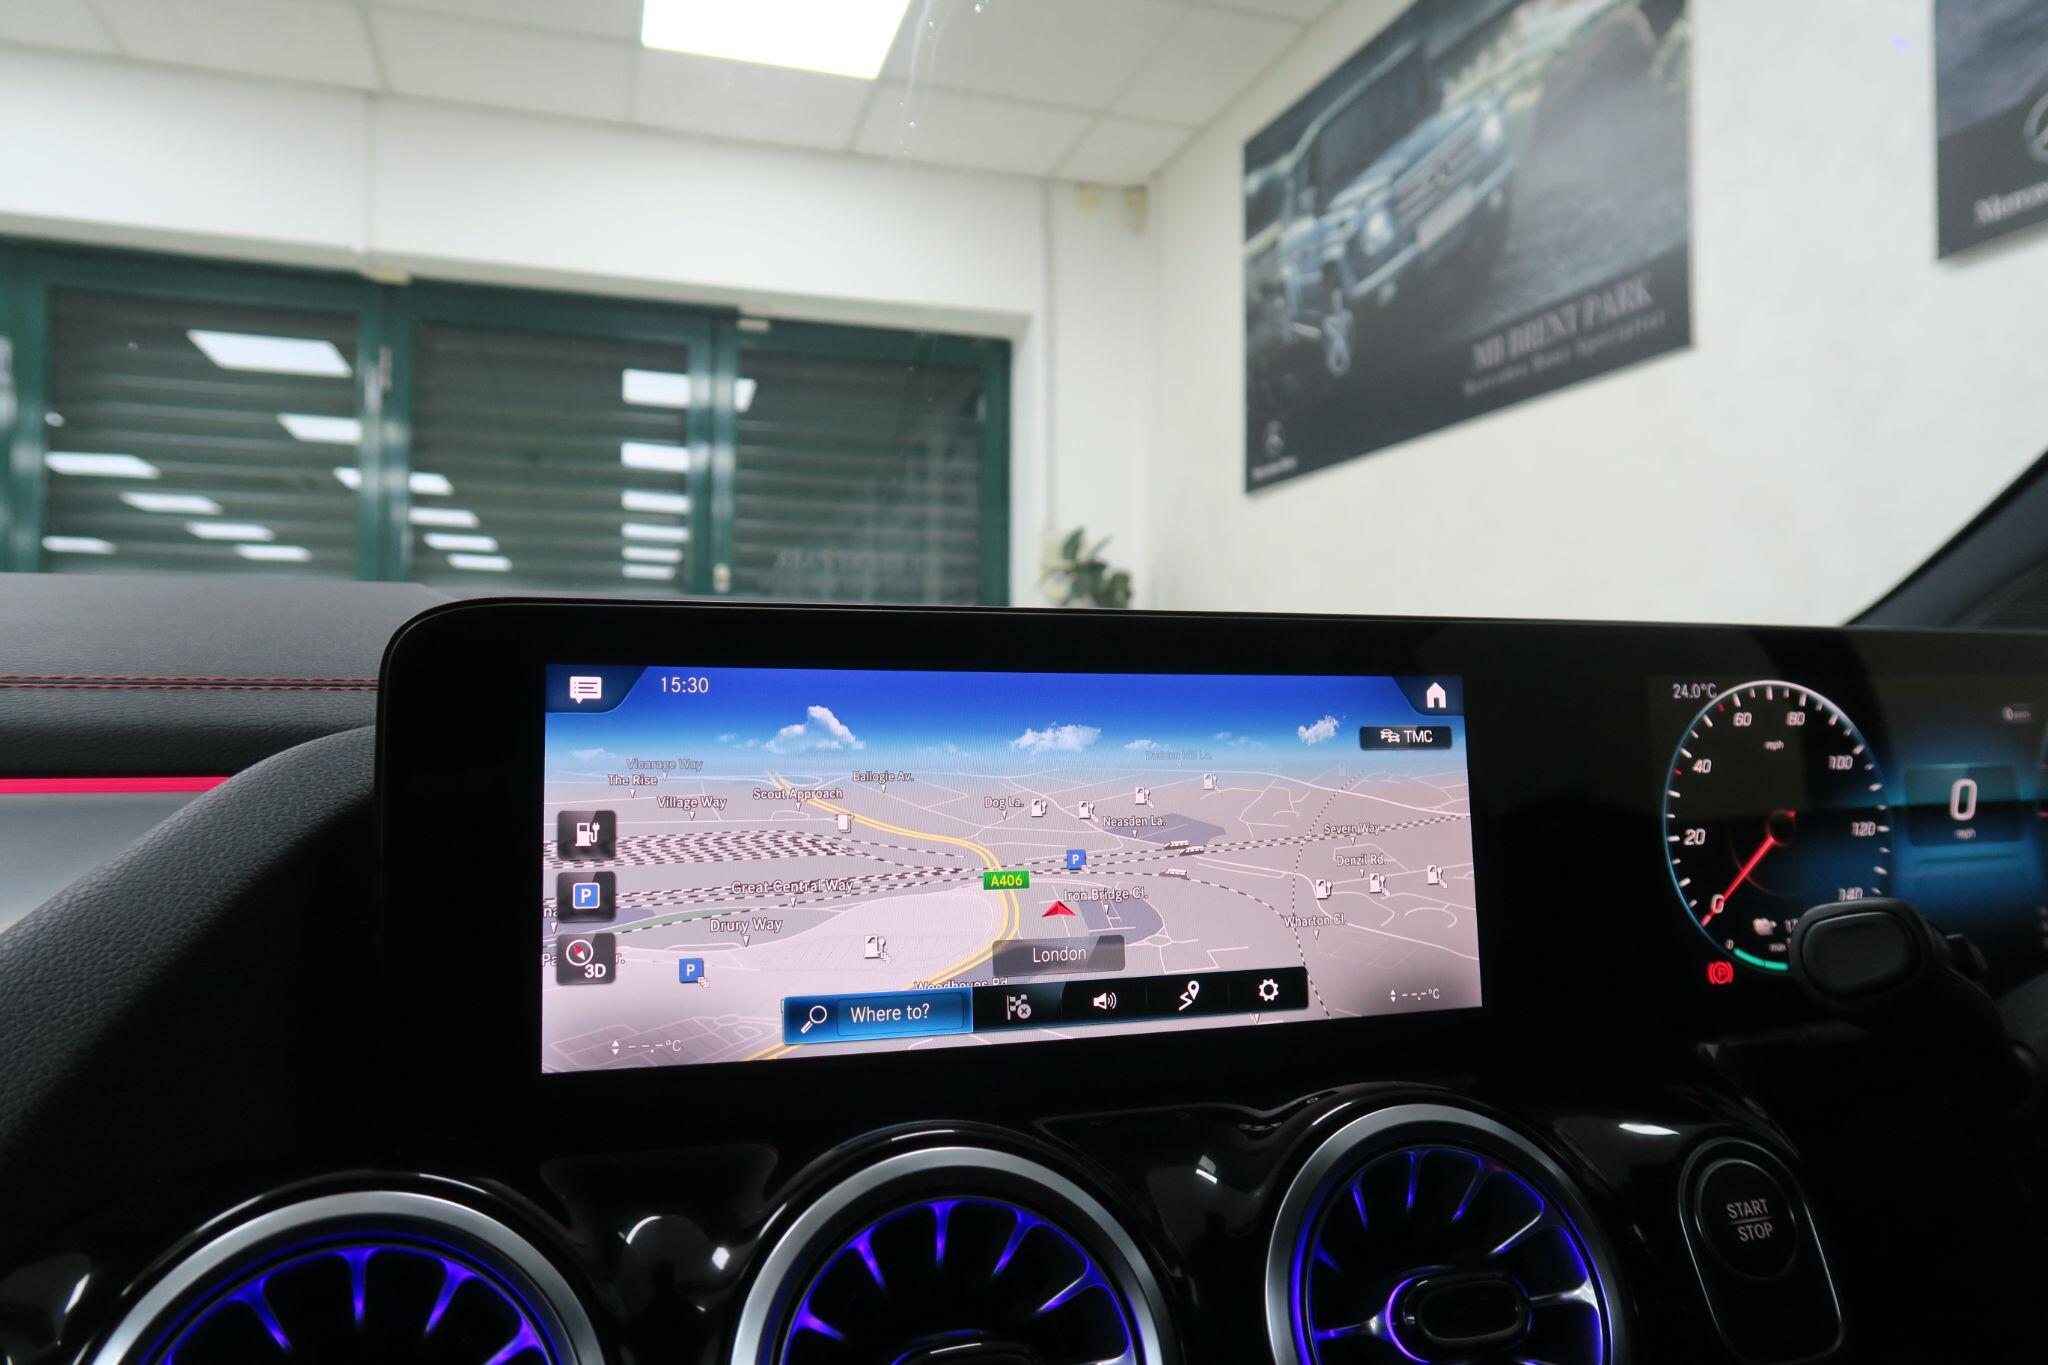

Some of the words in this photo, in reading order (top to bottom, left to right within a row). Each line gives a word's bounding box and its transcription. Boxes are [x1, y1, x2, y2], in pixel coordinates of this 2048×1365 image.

[1974, 182, 2048, 226] Merce
[1582, 271, 1653, 329] PARK
[661, 677, 709, 693] 15:30
[1672, 683, 1717, 699] 24.0°C
[1733, 712, 1752, 727] 60
[1786, 711, 1805, 726] 80
[1404, 730, 1433, 743] TMC
[627, 758, 676, 773] Vicarage
[678, 758, 703, 772] Way
[1692, 759, 1712, 774] 40
[1829, 755, 1853, 770] 100
[608, 774, 629, 786] The
[633, 774, 658, 786] Rise
[853, 771, 895, 783] Ballogie
[897, 771, 914, 782] Av.
[753, 788, 786, 800] Scout
[789, 788, 843, 801] Approach
[1950, 778, 1977, 821] 0
[657, 796, 698, 810] Village
[700, 796, 727, 810] Way
[985, 797, 1006, 809] Dog
[1008, 797, 1024, 807] La.
[1103, 816, 1148, 828] Neasden
[1150, 816, 1166, 827] La.
[1324, 823, 1358, 834] Severn
[1359, 823, 1381, 836] Way
[1852, 821, 1876, 836] 120
[1684, 828, 1706, 846] 20
[1336, 854, 1367, 866] Denzil
[1370, 854, 1388, 865] Rd.
[731, 881, 769, 894] Great
[772, 879, 822, 893] Central
[825, 878, 854, 893] Way
[990, 875, 1023, 887] A406
[1064, 889, 1088, 901] Iron
[1091, 888, 1129, 902] Bridge
[1132, 886, 1149, 899] Cl.
[1711, 894, 1724, 913] 0
[710, 919, 749, 934] Drury
[752, 917, 783, 933] Way
[1284, 915, 1330, 928] Wharton
[1333, 913, 1348, 924] Cl.
[1032, 947, 1087, 963] London
[585, 963, 607, 978] 3D
[850, 1006, 901, 1024] Where
[907, 1003, 930, 1020] to?
[1726, 1199, 1768, 1219] START
[1737, 1222, 1773, 1242] STOP
